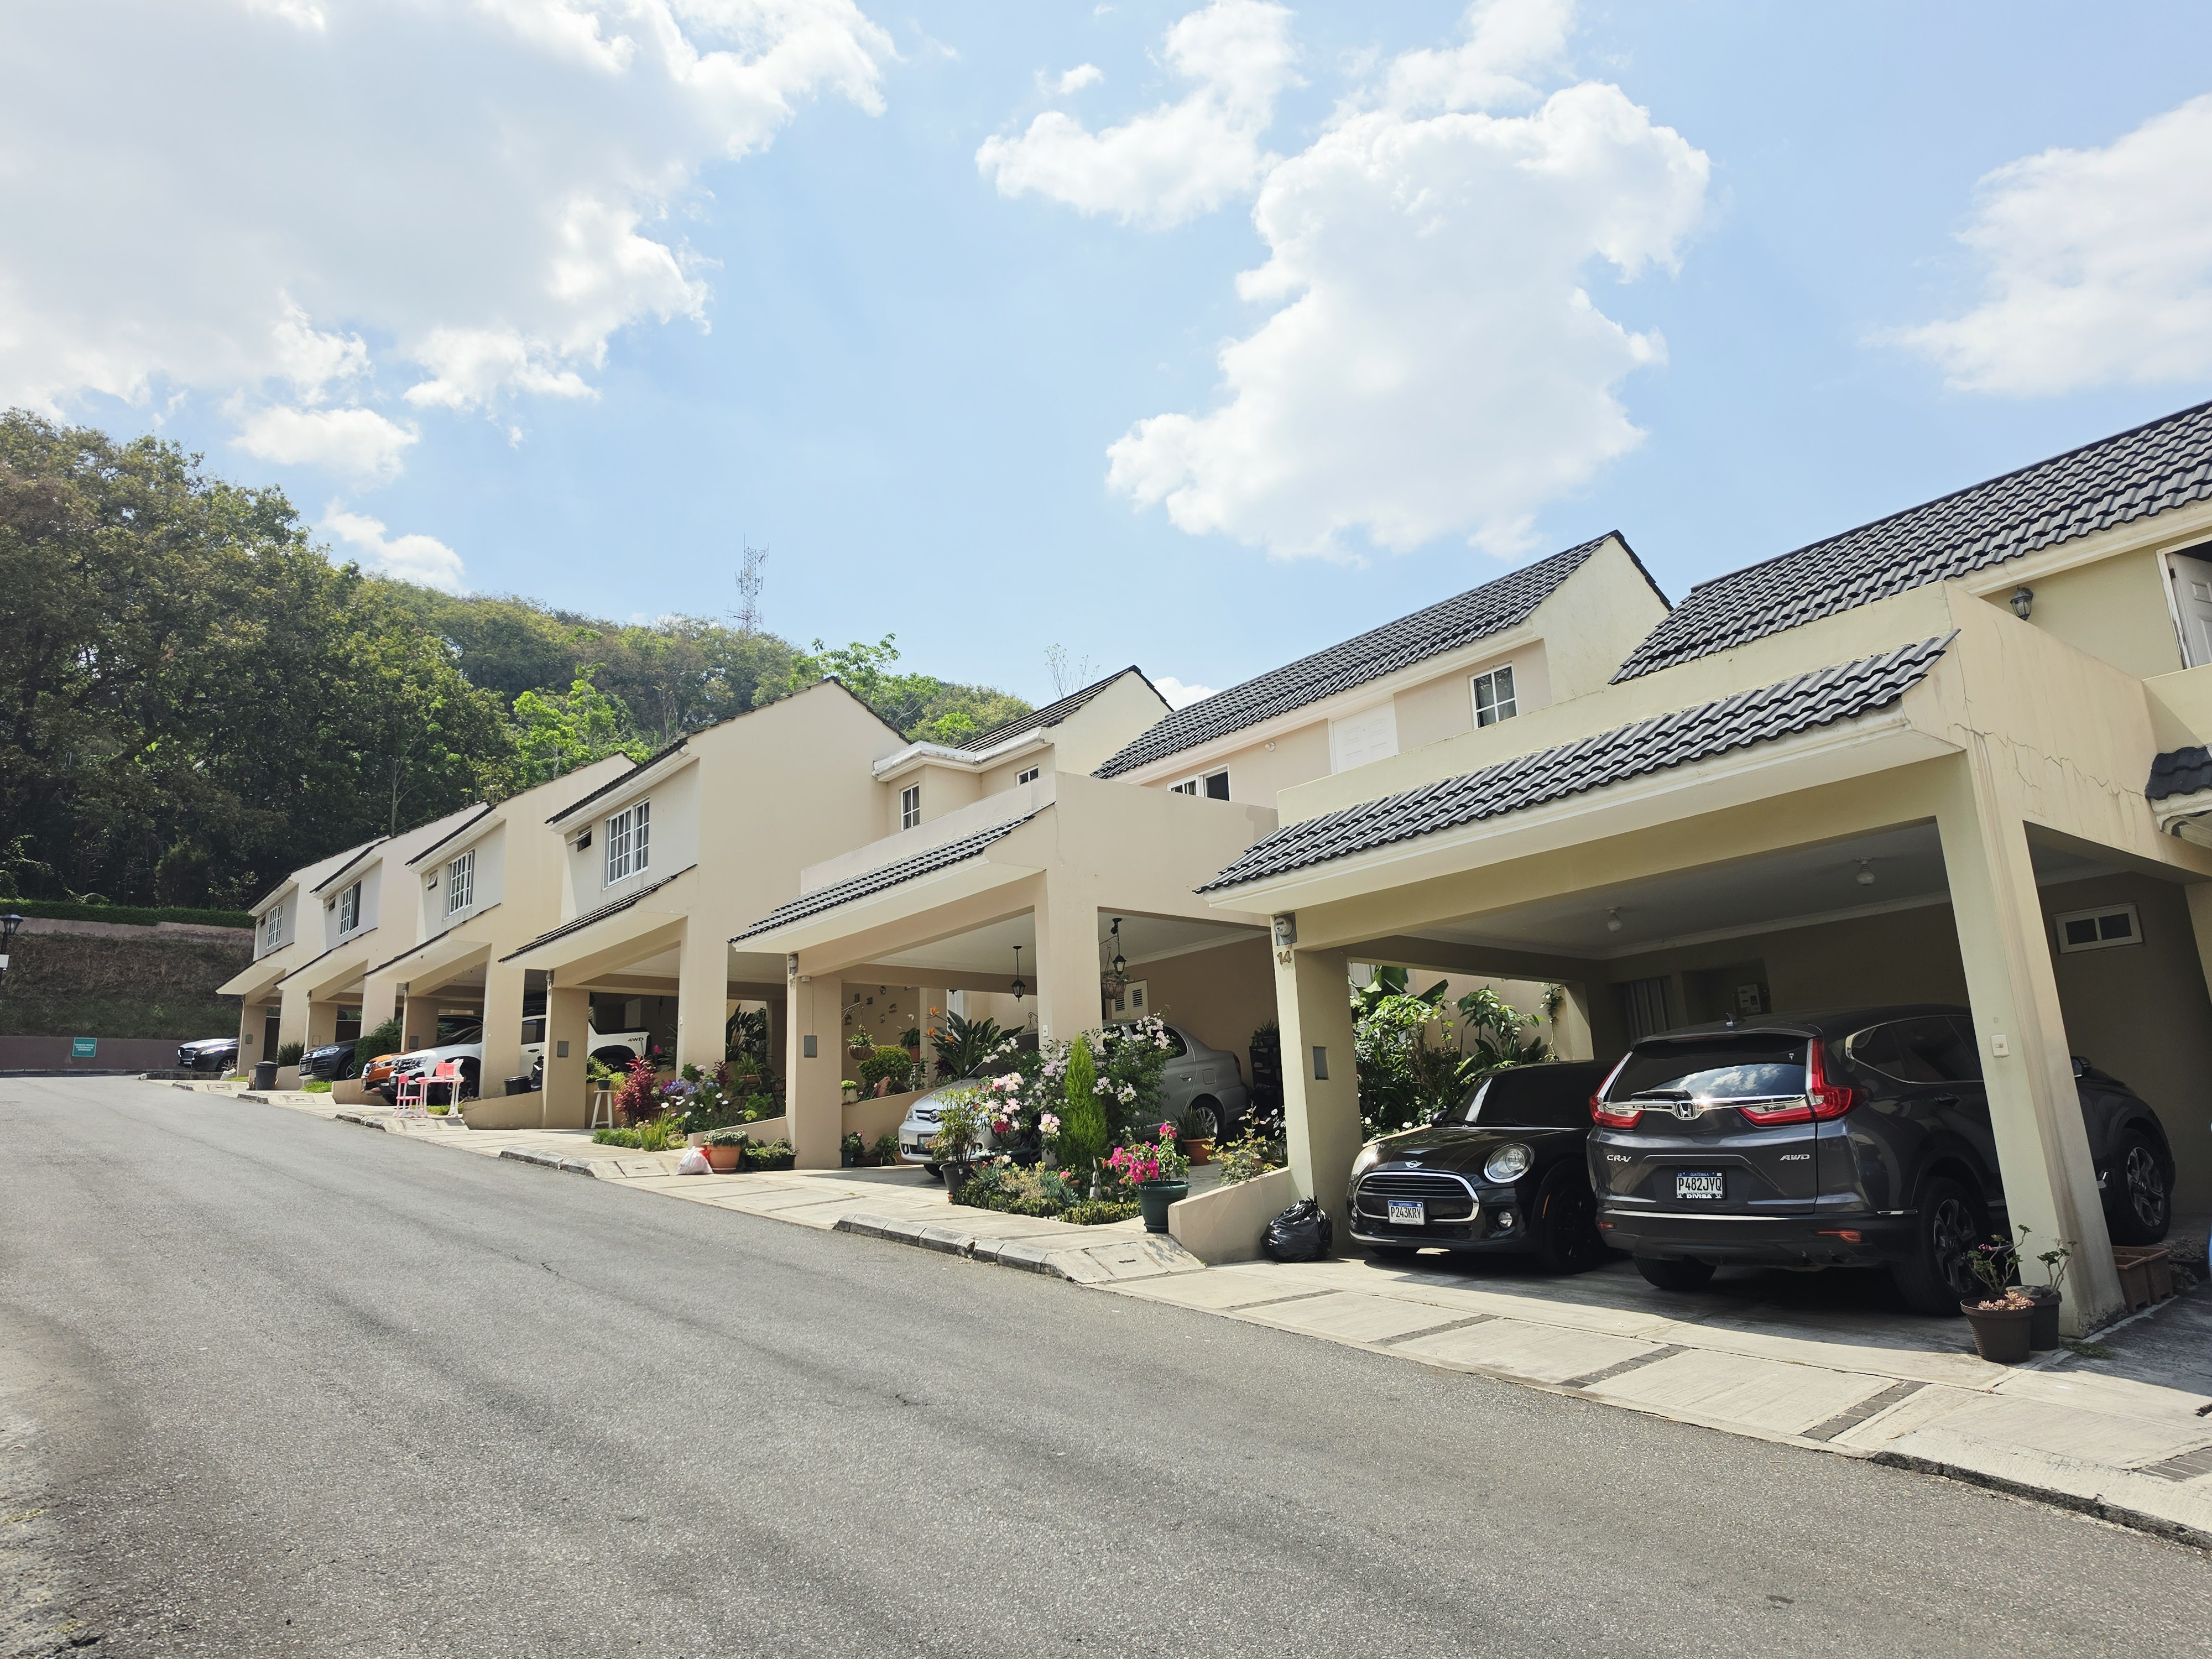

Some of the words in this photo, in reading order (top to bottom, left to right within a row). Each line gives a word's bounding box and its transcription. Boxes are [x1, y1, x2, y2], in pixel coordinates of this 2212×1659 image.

[1277, 950, 1292, 965] 14
[1606, 1154, 1632, 1162] CR-V
[1678, 1177, 1721, 1191] P482JYQ
[1390, 1207, 1421, 1219] P243KRY
